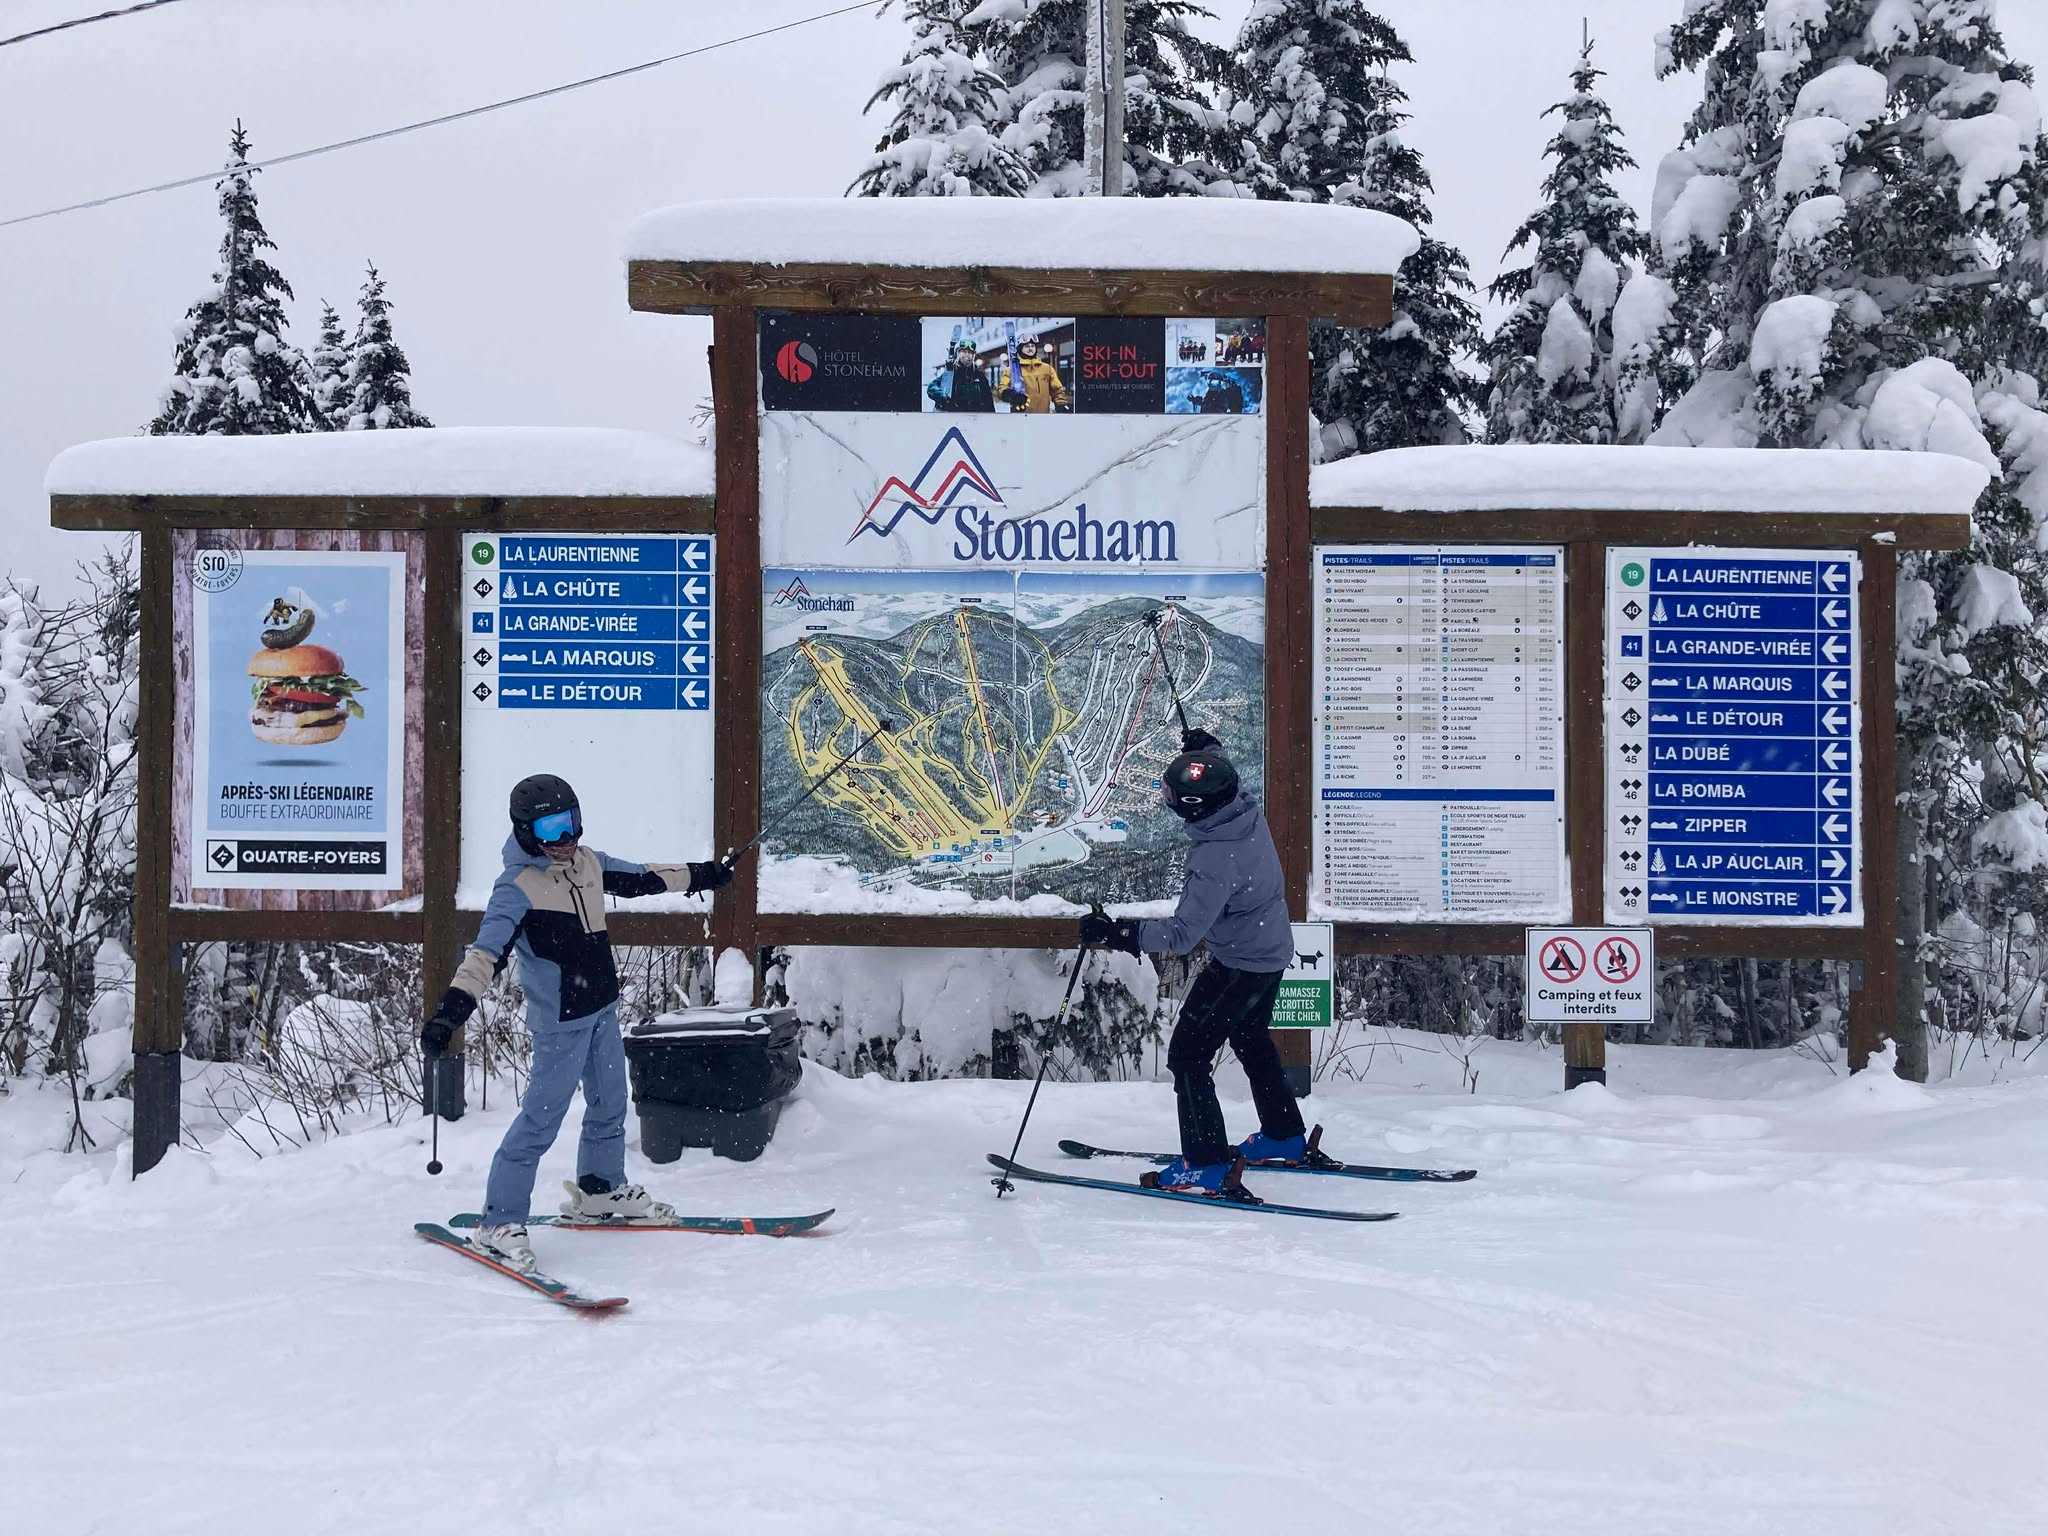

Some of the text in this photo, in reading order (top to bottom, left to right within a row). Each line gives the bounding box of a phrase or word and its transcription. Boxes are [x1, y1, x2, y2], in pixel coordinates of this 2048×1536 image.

[824, 349, 864, 362] HÔTEL
[1083, 345, 1136, 360] SKI-IN
[824, 364, 906, 376] STONEHAM
[1083, 363, 1157, 378] SKI-OUT
[954, 503, 1178, 562] Stoneham
[478, 547, 639, 563] 19 LA LAURENTIENNE
[1627, 569, 1812, 584] 19 LA LAURENTIENNE
[477, 578, 620, 597] 40 LA CHÛTE
[797, 596, 855, 612] Stoneham
[1626, 602, 1760, 619] 40 LA CHÛTE
[477, 613, 637, 632] 41 LA GRANDE-VIRÉE
[1626, 639, 1811, 656] 41 LA GRANDE-VIRÉE
[477, 650, 655, 667] 42 LA MARQUIS
[476, 681, 642, 701] 43 LE DÉTOUR
[1624, 676, 1793, 692] 42 LA MARQUIS
[1624, 708, 1783, 726] 43 LE DÉTOUR
[1624, 744, 1730, 764] 45 LA DUBÉ
[221, 781, 373, 801] APRÈS-SKI LÉGENDAIRE
[1624, 784, 1746, 800] 46 LA BOMBA
[221, 803, 373, 820] BOUFFE EXTRAORDINAIRE
[1624, 818, 1747, 835] 47 ZIPPER
[242, 850, 381, 865] QUATRE-FOYERS
[1624, 855, 1803, 871] 48 LA JP AUCLAIR
[1624, 891, 1798, 907] 49 LE MONSTRE
[1280, 988, 1320, 997] RAMASSEZ
[1538, 989, 1642, 1002] Camping et feux
[1282, 999, 1314, 1009] CROTTES
[1564, 1003, 1616, 1014] interdits
[1272, 1012, 1320, 1021] VOTRE CHIEN
